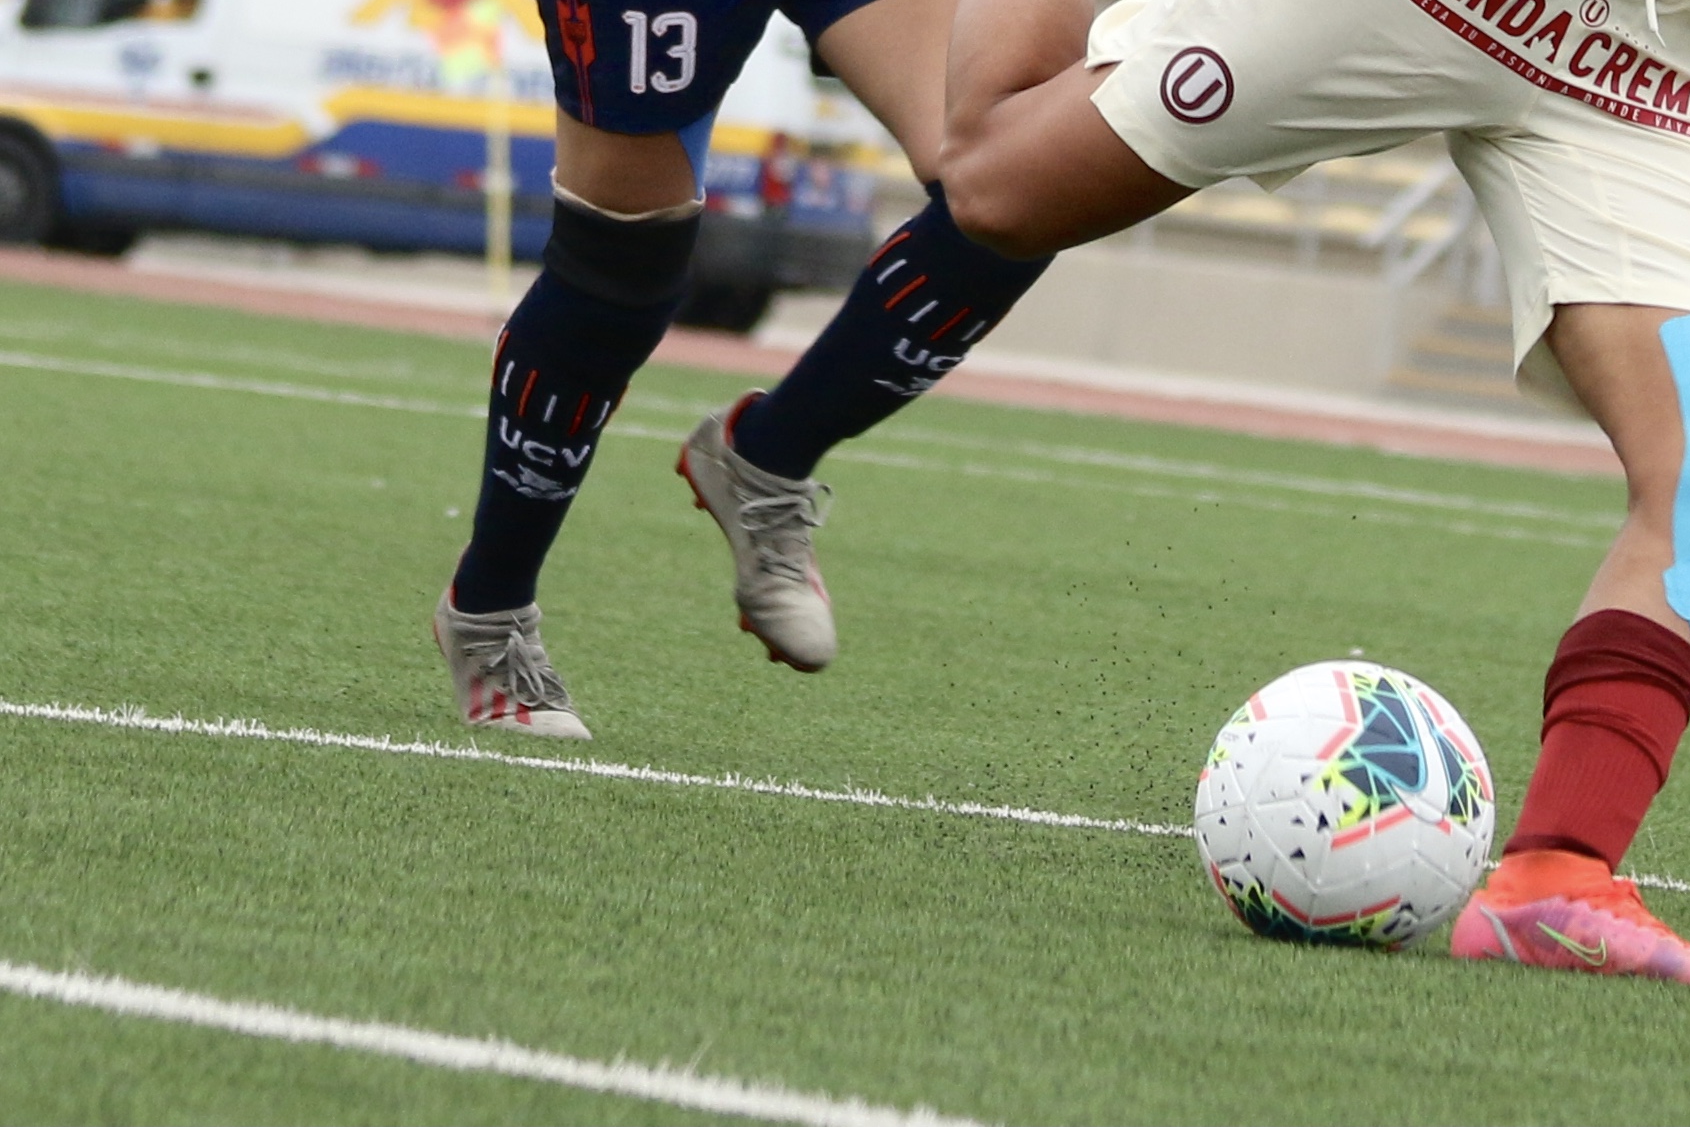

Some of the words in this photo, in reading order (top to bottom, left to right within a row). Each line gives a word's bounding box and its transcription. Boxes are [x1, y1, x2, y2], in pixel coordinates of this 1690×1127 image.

[621, 9, 699, 95] 13
[1458, 22, 1479, 41] TU
[1559, 84, 1570, 95] A
[1583, 92, 1641, 122] DONDE
[498, 414, 591, 468] UCV
